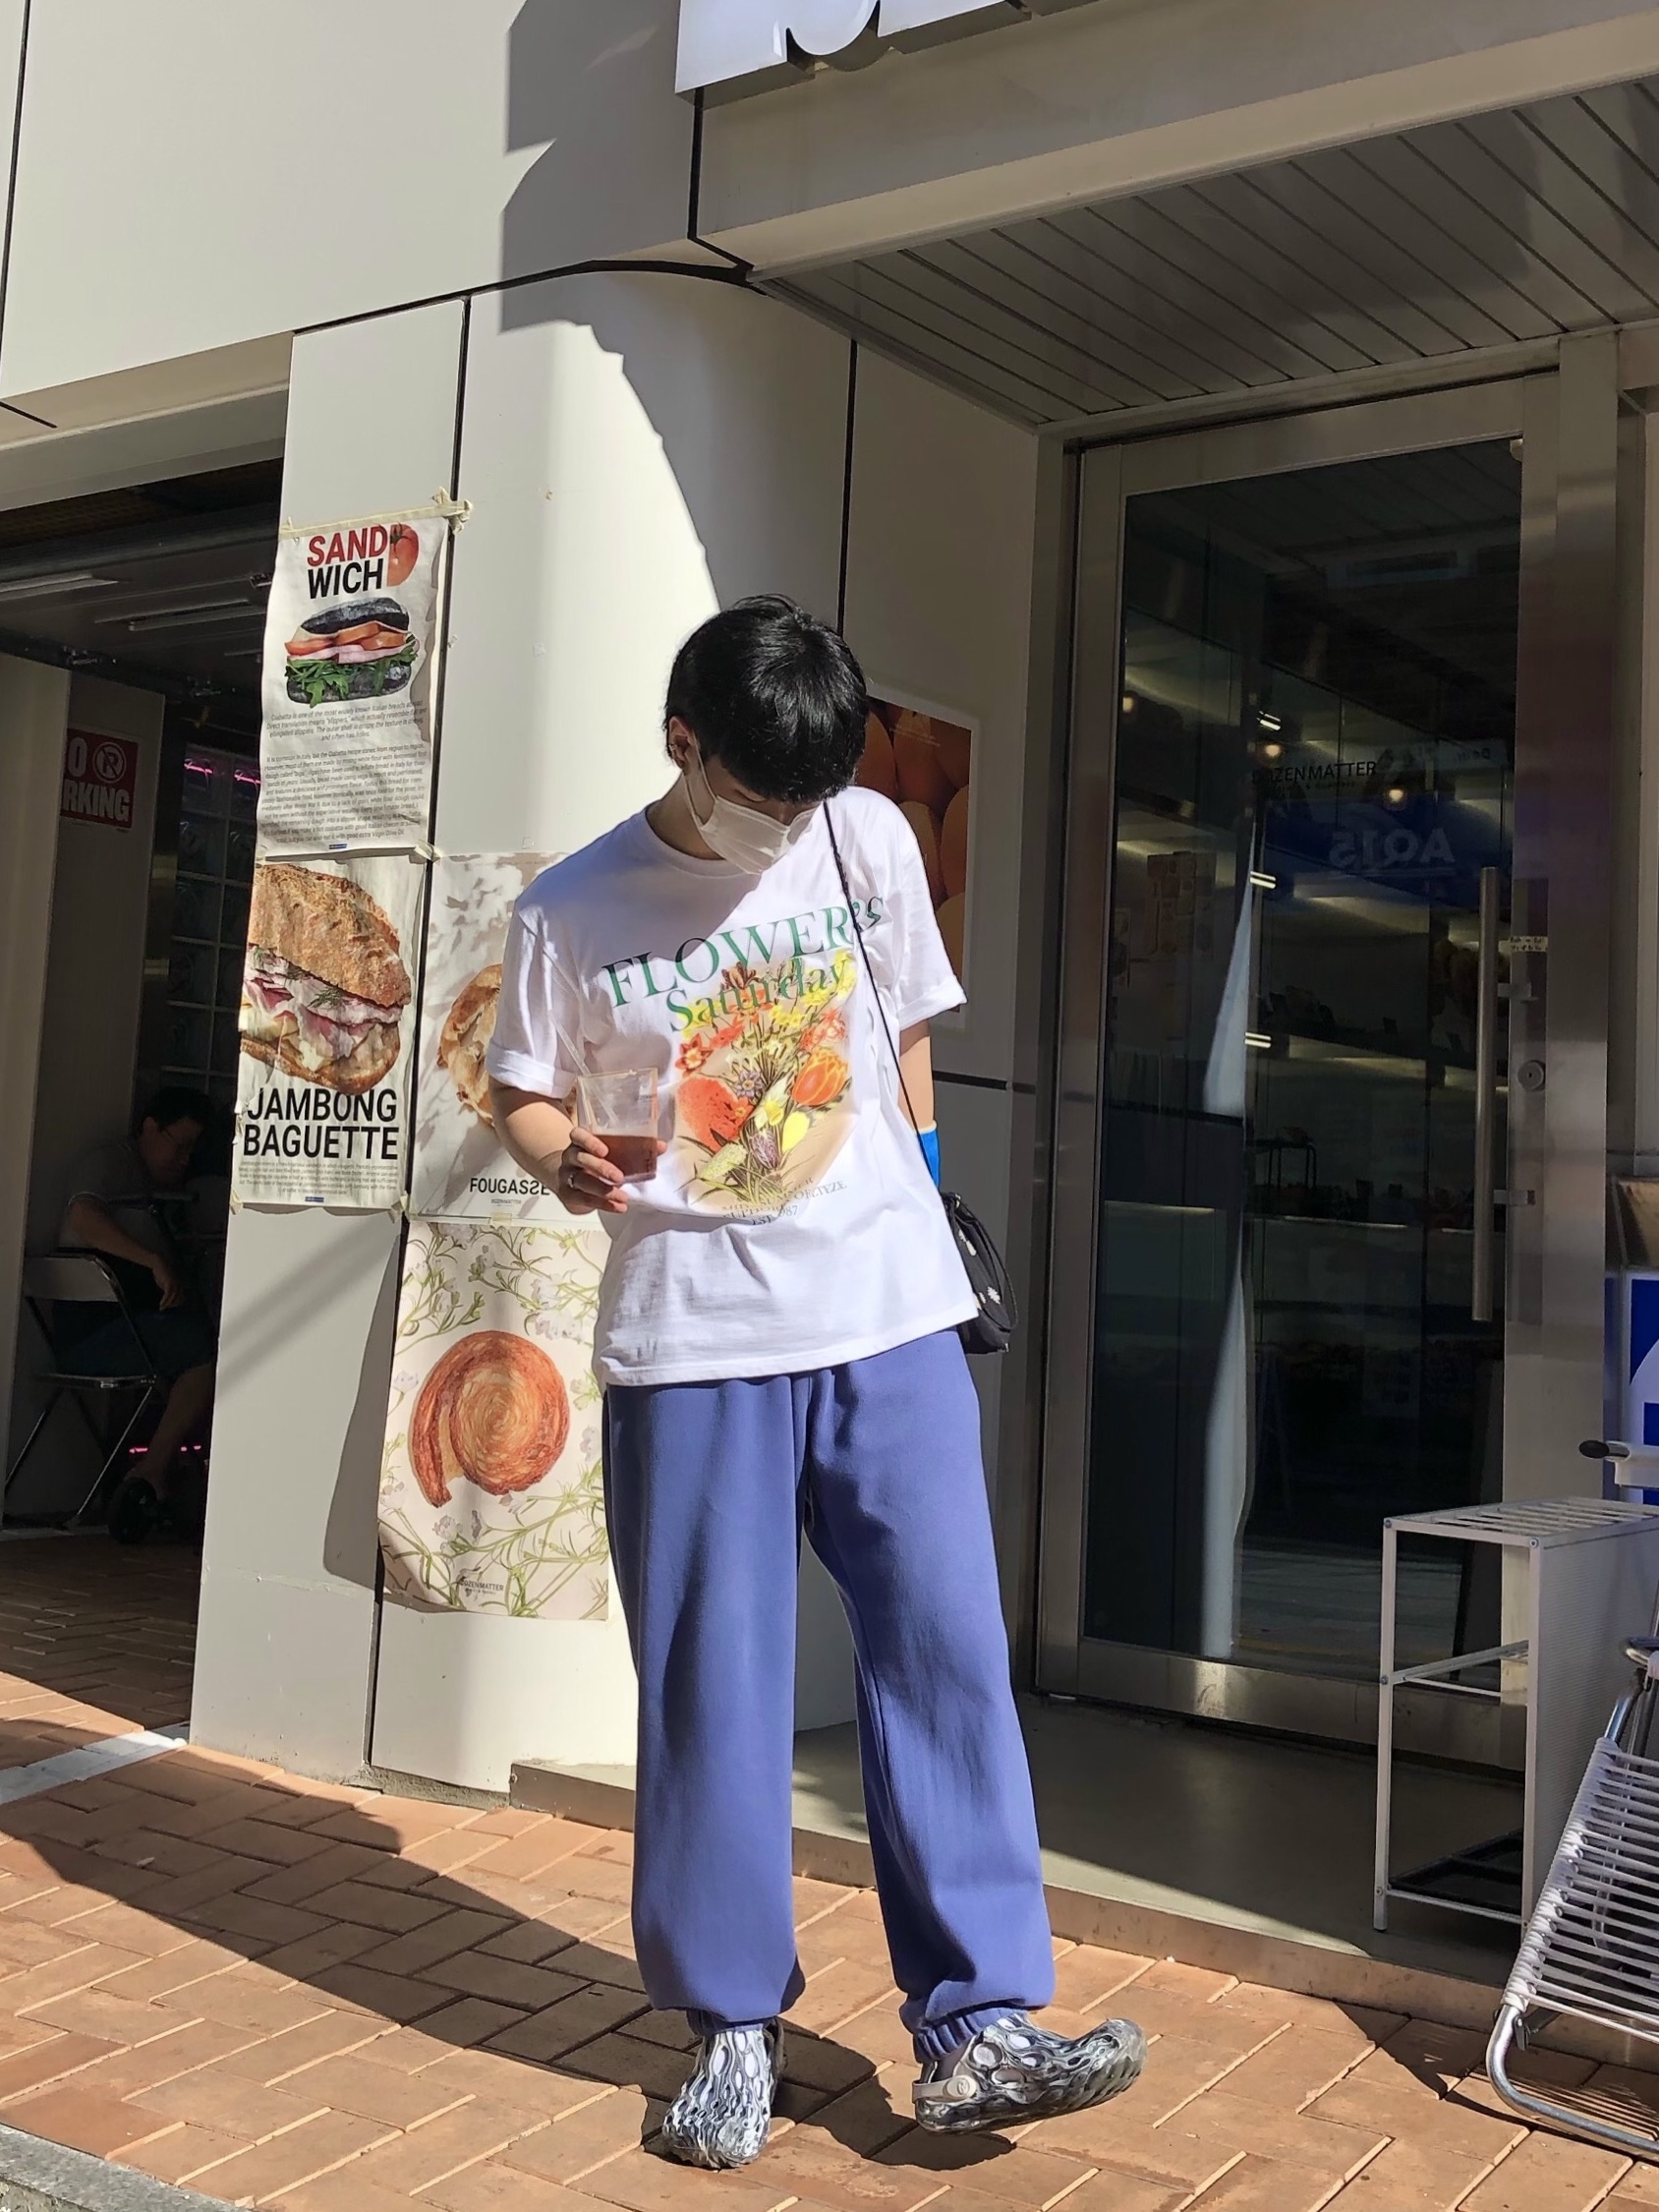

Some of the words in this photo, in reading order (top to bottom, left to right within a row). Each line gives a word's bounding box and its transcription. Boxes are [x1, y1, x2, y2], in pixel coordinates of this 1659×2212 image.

[307, 525, 388, 567] SAND
[308, 558, 384, 600] WICH
[68, 736, 88, 778] O
[62, 780, 130, 822] RKING
[665, 955, 851, 1032] Saturday
[247, 1087, 398, 1123] JAMBONG
[243, 1124, 400, 1160] BAGUETTE
[470, 1177, 550, 1195] FOUGASSE
